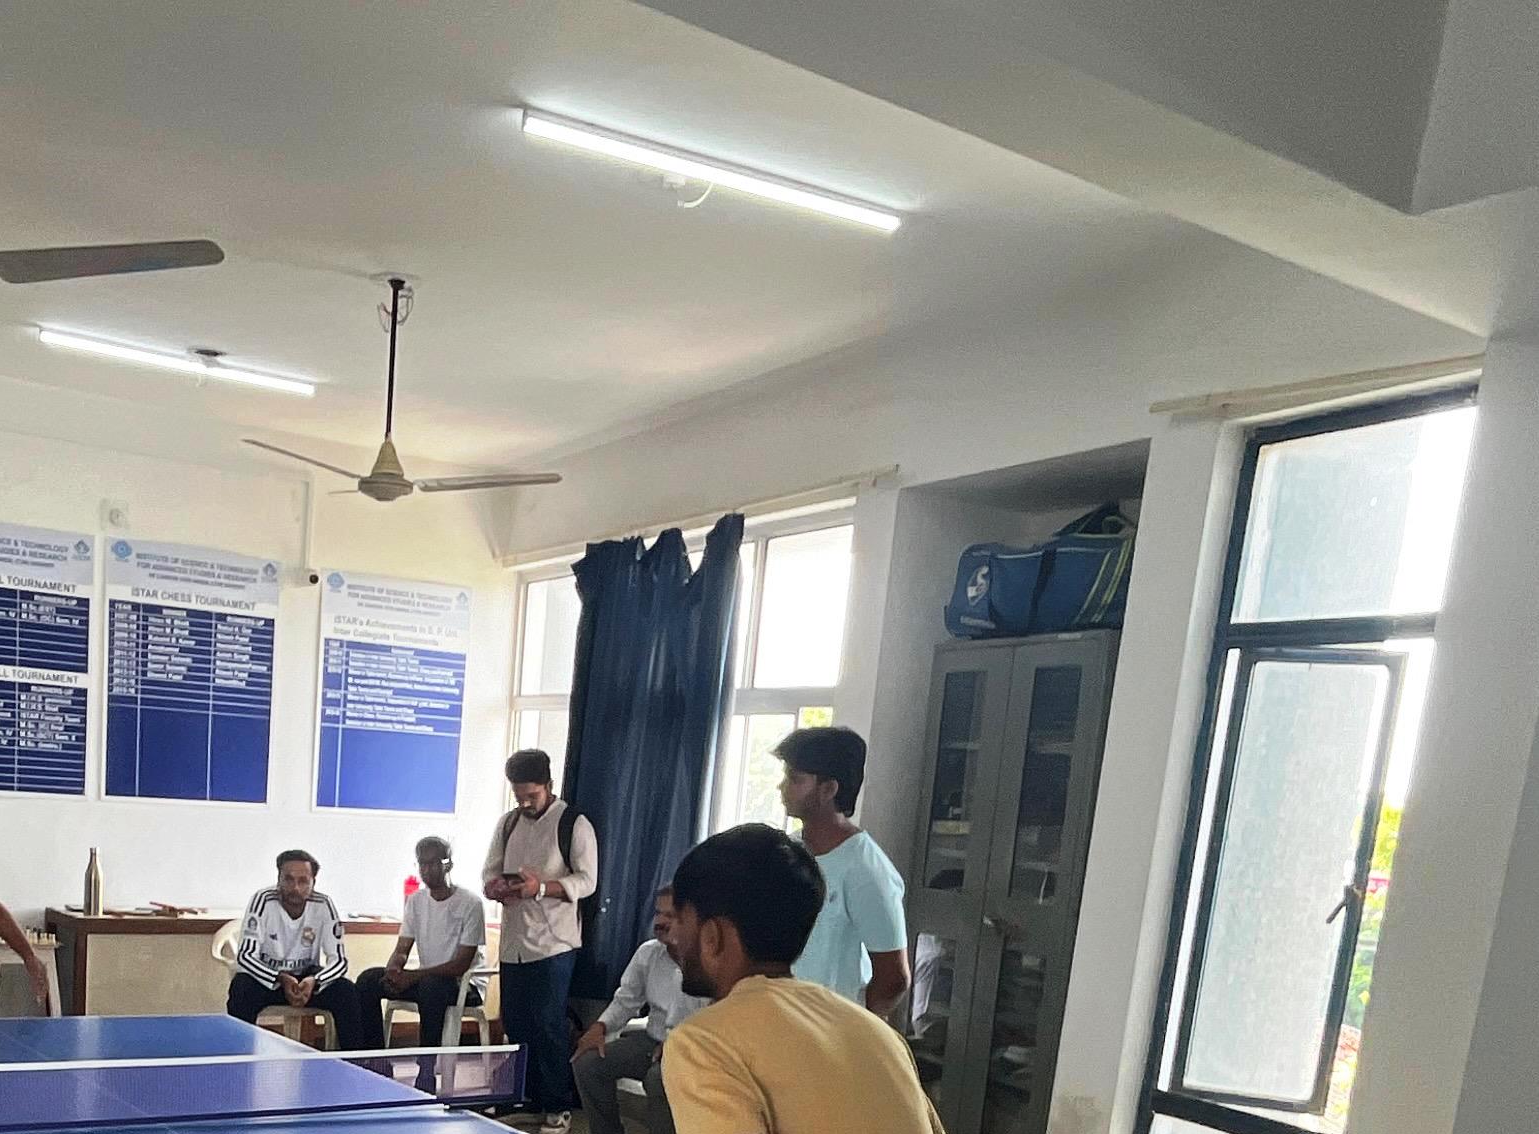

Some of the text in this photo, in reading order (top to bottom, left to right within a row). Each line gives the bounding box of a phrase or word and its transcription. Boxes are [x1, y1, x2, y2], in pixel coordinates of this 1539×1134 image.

[21, 540, 69, 553] TECHNOLOGY
[29, 550, 67, 562] RESEARCH
[7, 576, 77, 594] TOURNAMENT
[131, 587, 257, 611] ISTAR CHESS TOURNAMENT
[11, 669, 79, 684] TOURNAMENT
